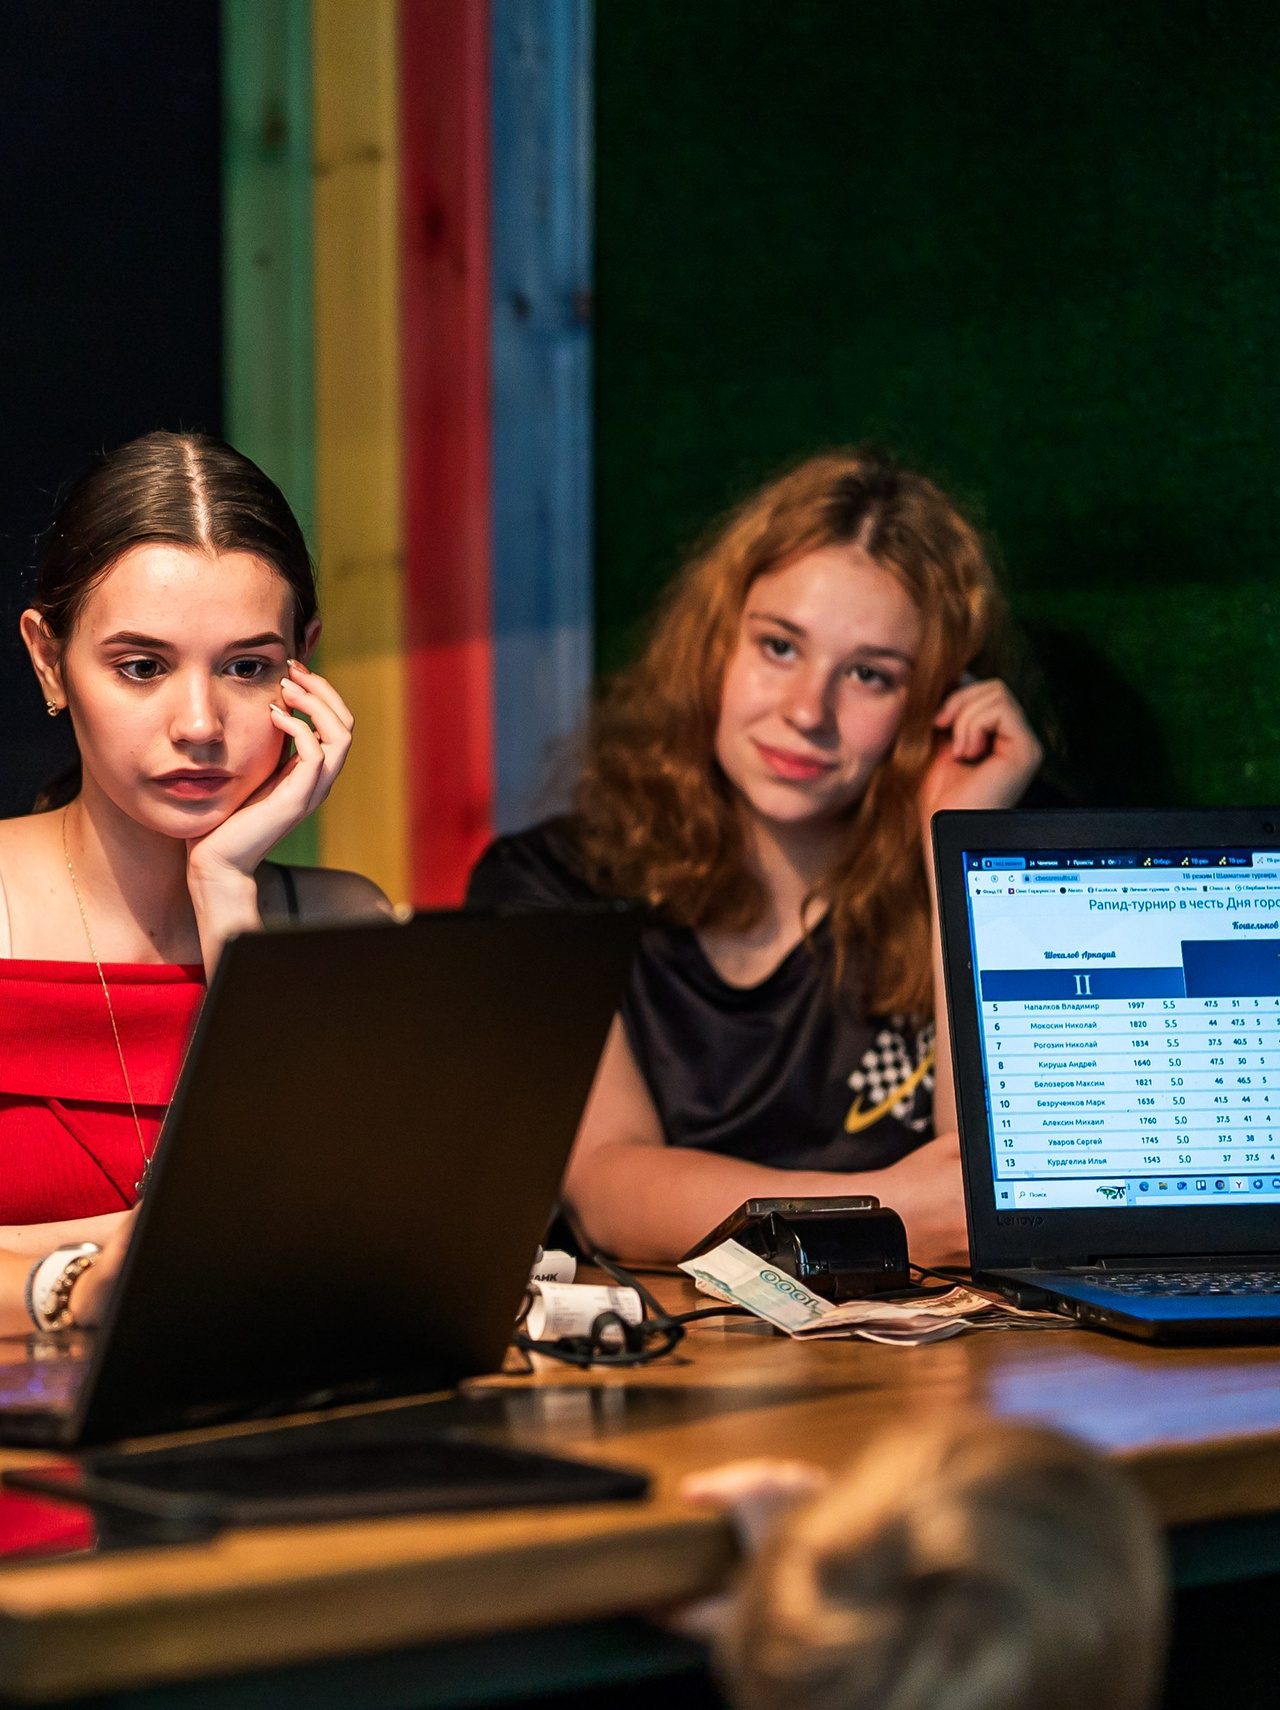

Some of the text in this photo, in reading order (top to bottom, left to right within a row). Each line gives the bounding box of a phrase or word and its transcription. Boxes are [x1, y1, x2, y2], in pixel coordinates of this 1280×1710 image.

[1089, 899, 1176, 913] Рапид-турнир
[1189, 899, 1224, 909] честь
[1226, 898, 1251, 910] Дня
[1232, 921, 1279, 930] Кошельков
[1082, 951, 1116, 960] Аркадий
[1163, 1001, 1175, 1009] 5.5
[995, 1023, 1000, 1031] 6
[1165, 1020, 1177, 1028] 5.5
[997, 1042, 1001, 1050] 7
[1167, 1039, 1179, 1047] 5.5
[1169, 1058, 1181, 1066] 5.0
[1000, 1081, 1005, 1089] 9
[1171, 1078, 1183, 1086] 5.0
[1000, 1100, 1009, 1108] 10
[1037, 1100, 1084, 1108] Безрученков
[1173, 1097, 1185, 1105] 5.0
[1175, 1116, 1187, 1124] 5.0
[1004, 1139, 1013, 1147] 12
[1077, 1138, 1102, 1146] Сергей
[1177, 1136, 1189, 1144] 5.0
[1006, 1159, 1015, 1167] 13
[1179, 1155, 1191, 1163] 5.0
[997, 1215, 1044, 1226] Lenovo
[529, 1272, 559, 1282] АНК
